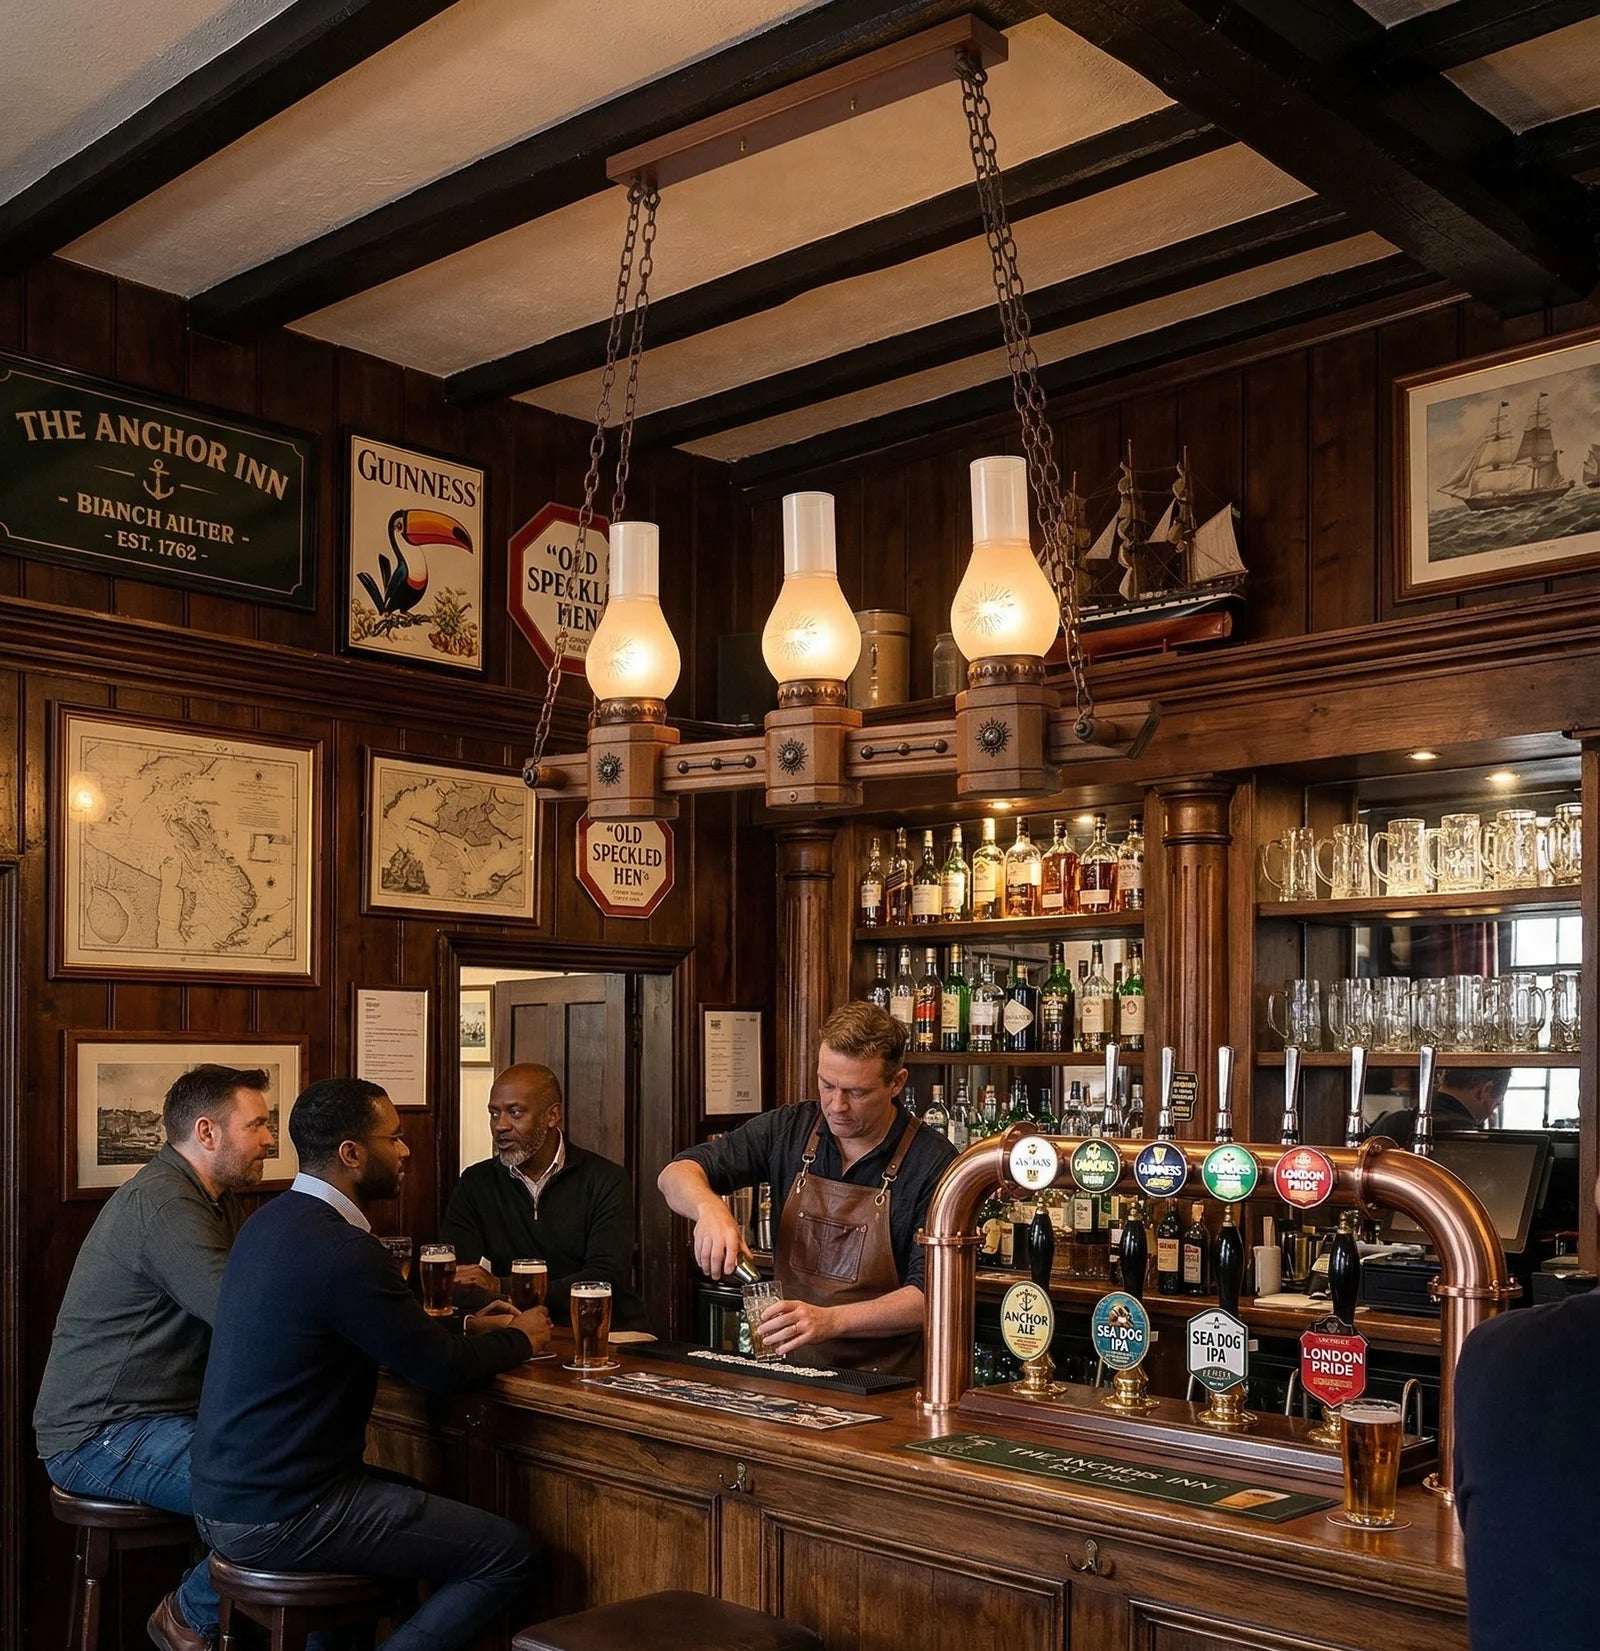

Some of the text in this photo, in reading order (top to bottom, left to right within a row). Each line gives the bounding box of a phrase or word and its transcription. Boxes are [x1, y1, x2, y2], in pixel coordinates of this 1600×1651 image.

[15, 410, 289, 501] THE ANCHOR INN
[357, 448, 476, 508] GUINNESS
[116, 530, 197, 562] EST. 1762
[592, 842, 662, 868] SPECKLED
[1281, 1169, 1325, 1181] LONDON
[1004, 1311, 1048, 1327] ANCHOR
[1017, 1323, 1035, 1336] ALE
[1097, 1325, 1143, 1342] SEA DOG
[1111, 1338, 1129, 1352] IPA
[1192, 1330, 1241, 1350] SEA DOG
[1206, 1347, 1226, 1364] IPA
[1303, 1347, 1363, 1365] LONDON
[1311, 1361, 1354, 1377] PRIDE
[1009, 1447, 1056, 1461] THE
[1165, 1476, 1217, 1491] INN
